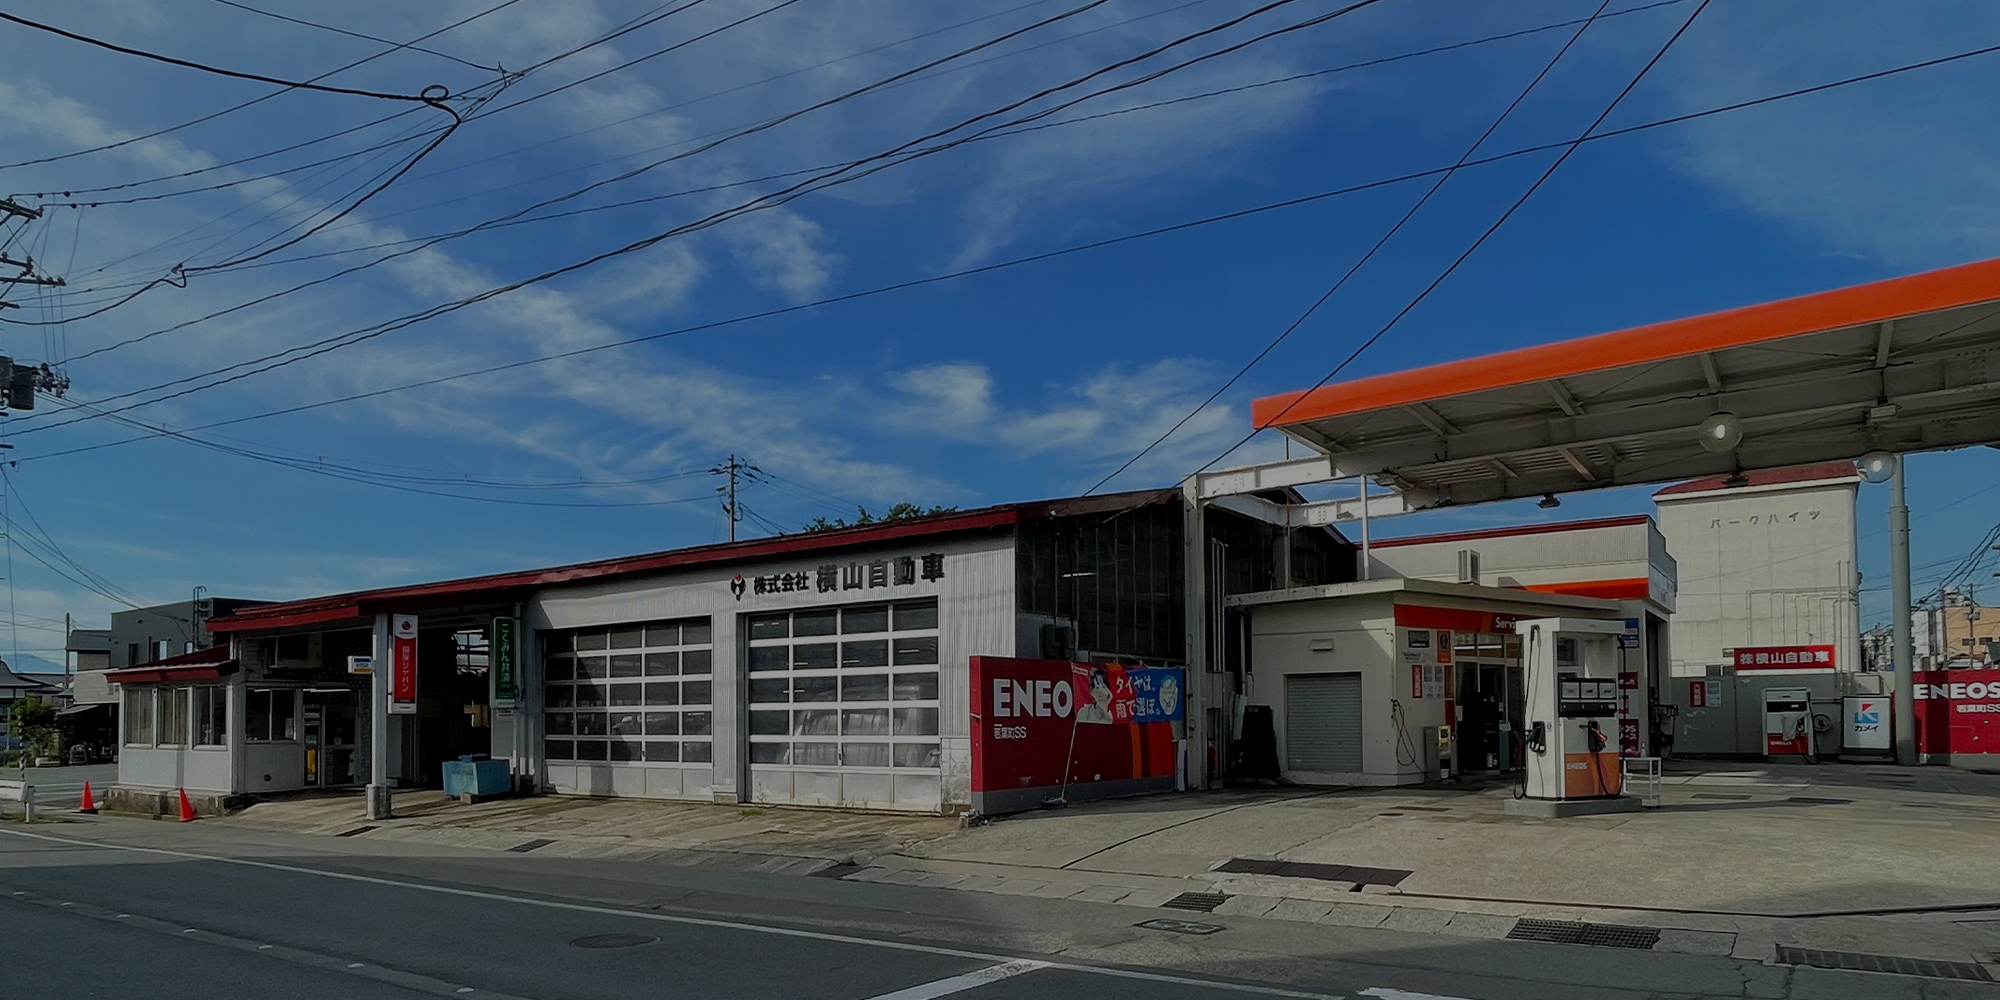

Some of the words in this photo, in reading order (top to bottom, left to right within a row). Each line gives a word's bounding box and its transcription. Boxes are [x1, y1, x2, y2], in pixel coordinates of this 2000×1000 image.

[753, 571, 810, 596] 株式会社
[816, 552, 945, 593] 横山自動車
[1494, 616, 1516, 630] Servi
[993, 678, 1074, 718] ENEO
[1912, 681, 2000, 700] ENEOS
[1854, 724, 1879, 733] カメイ
